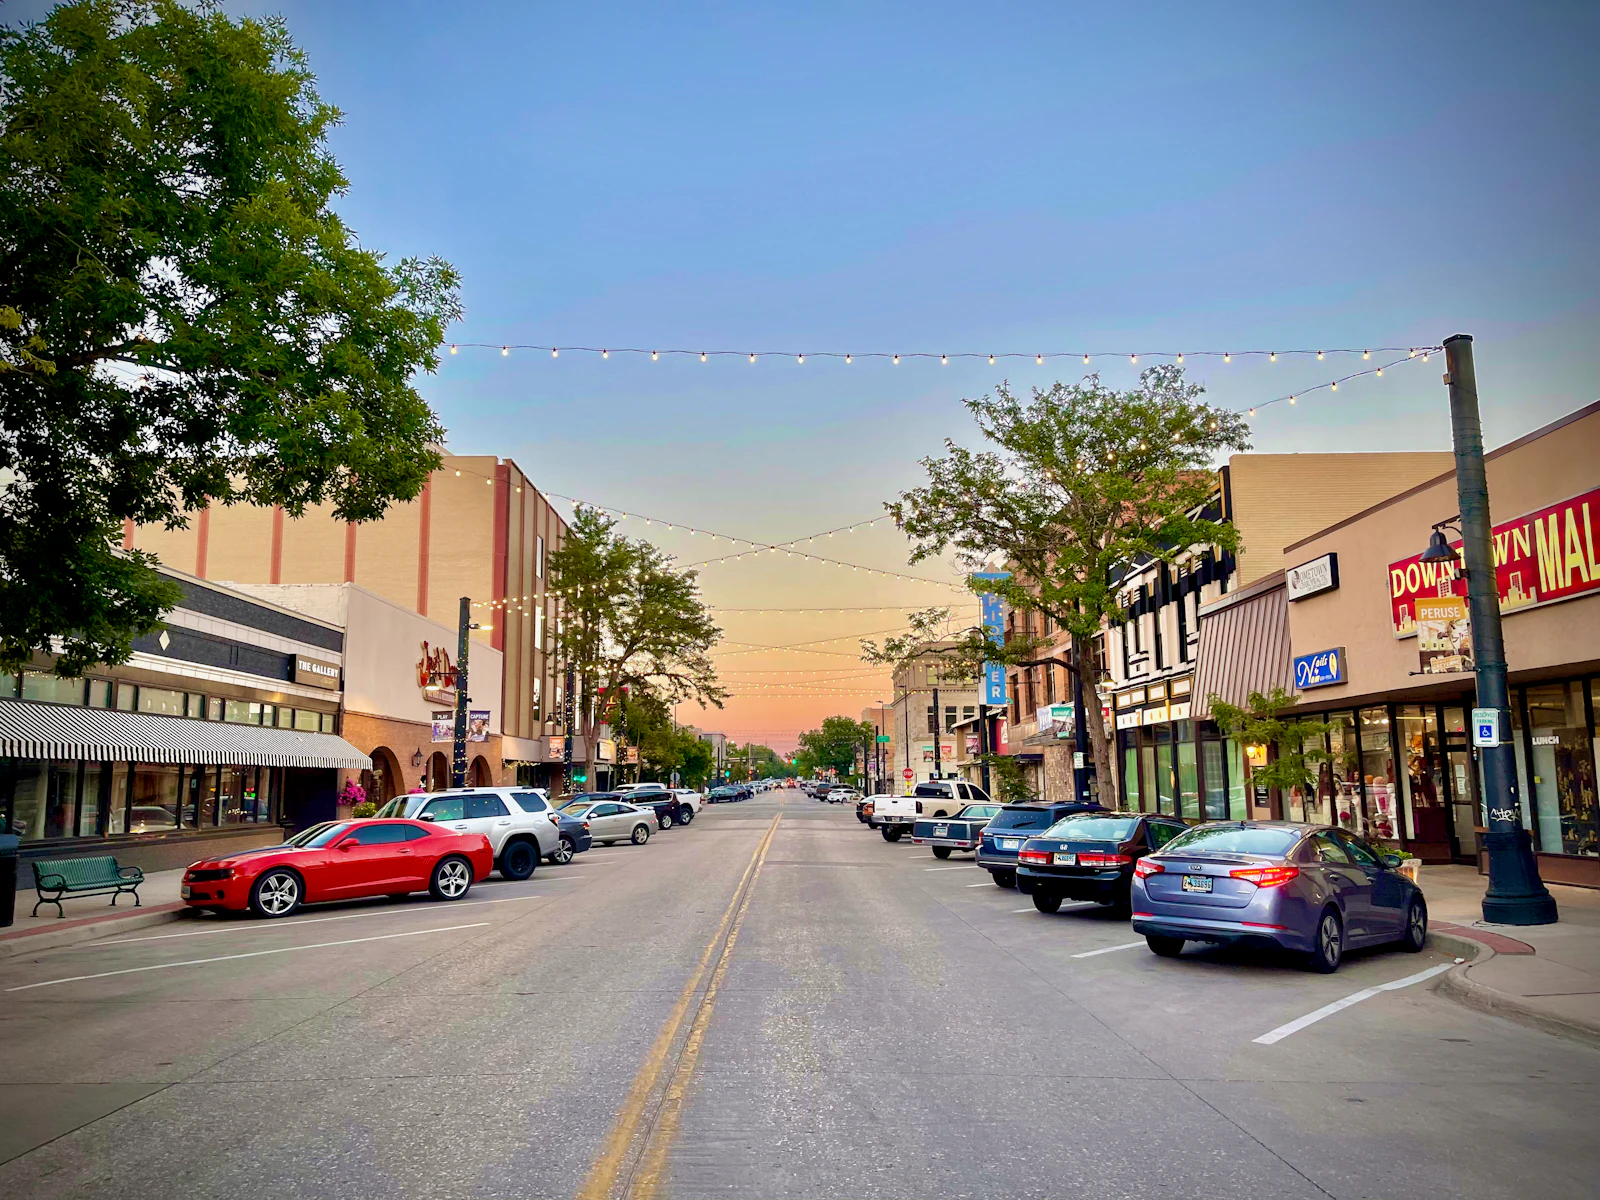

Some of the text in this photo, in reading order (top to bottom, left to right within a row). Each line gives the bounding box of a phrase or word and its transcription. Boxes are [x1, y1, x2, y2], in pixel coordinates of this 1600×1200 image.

[1421, 606, 1461, 619] PERUSE
[298, 660, 339, 678] THE GALLERY
[1532, 736, 1560, 746] LUNCH
